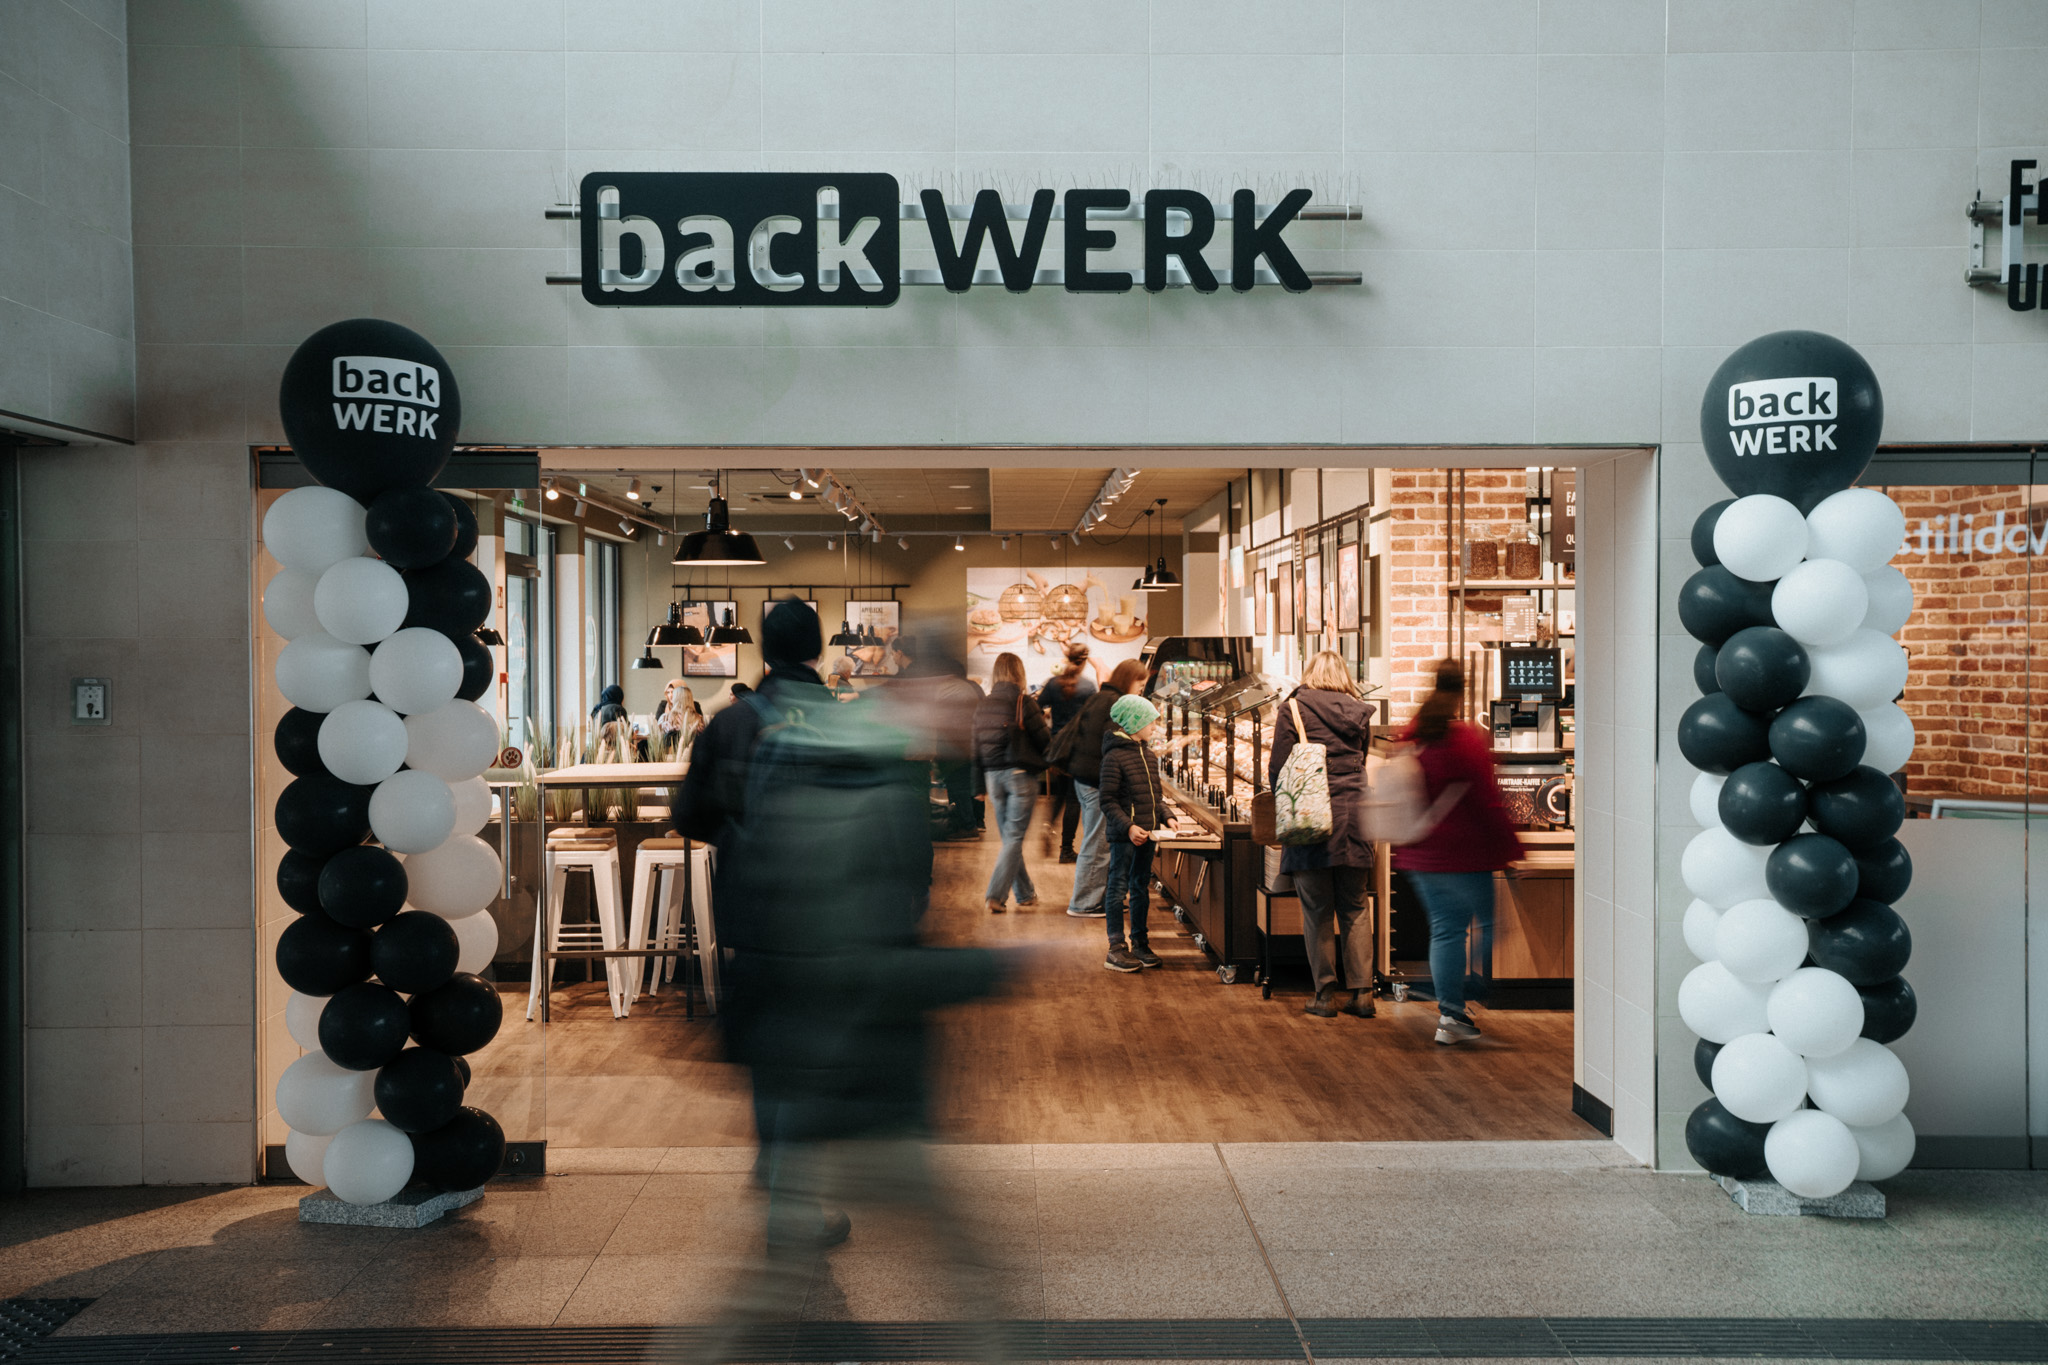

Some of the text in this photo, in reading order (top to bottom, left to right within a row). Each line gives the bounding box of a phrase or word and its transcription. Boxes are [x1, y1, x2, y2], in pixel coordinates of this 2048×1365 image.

[597, 184, 1313, 294] back WERK
[2007, 263, 2048, 312] u
[339, 360, 436, 403] back
[1734, 382, 1832, 421] back
[332, 402, 440, 440] WERK
[1729, 424, 1838, 457] WERK
